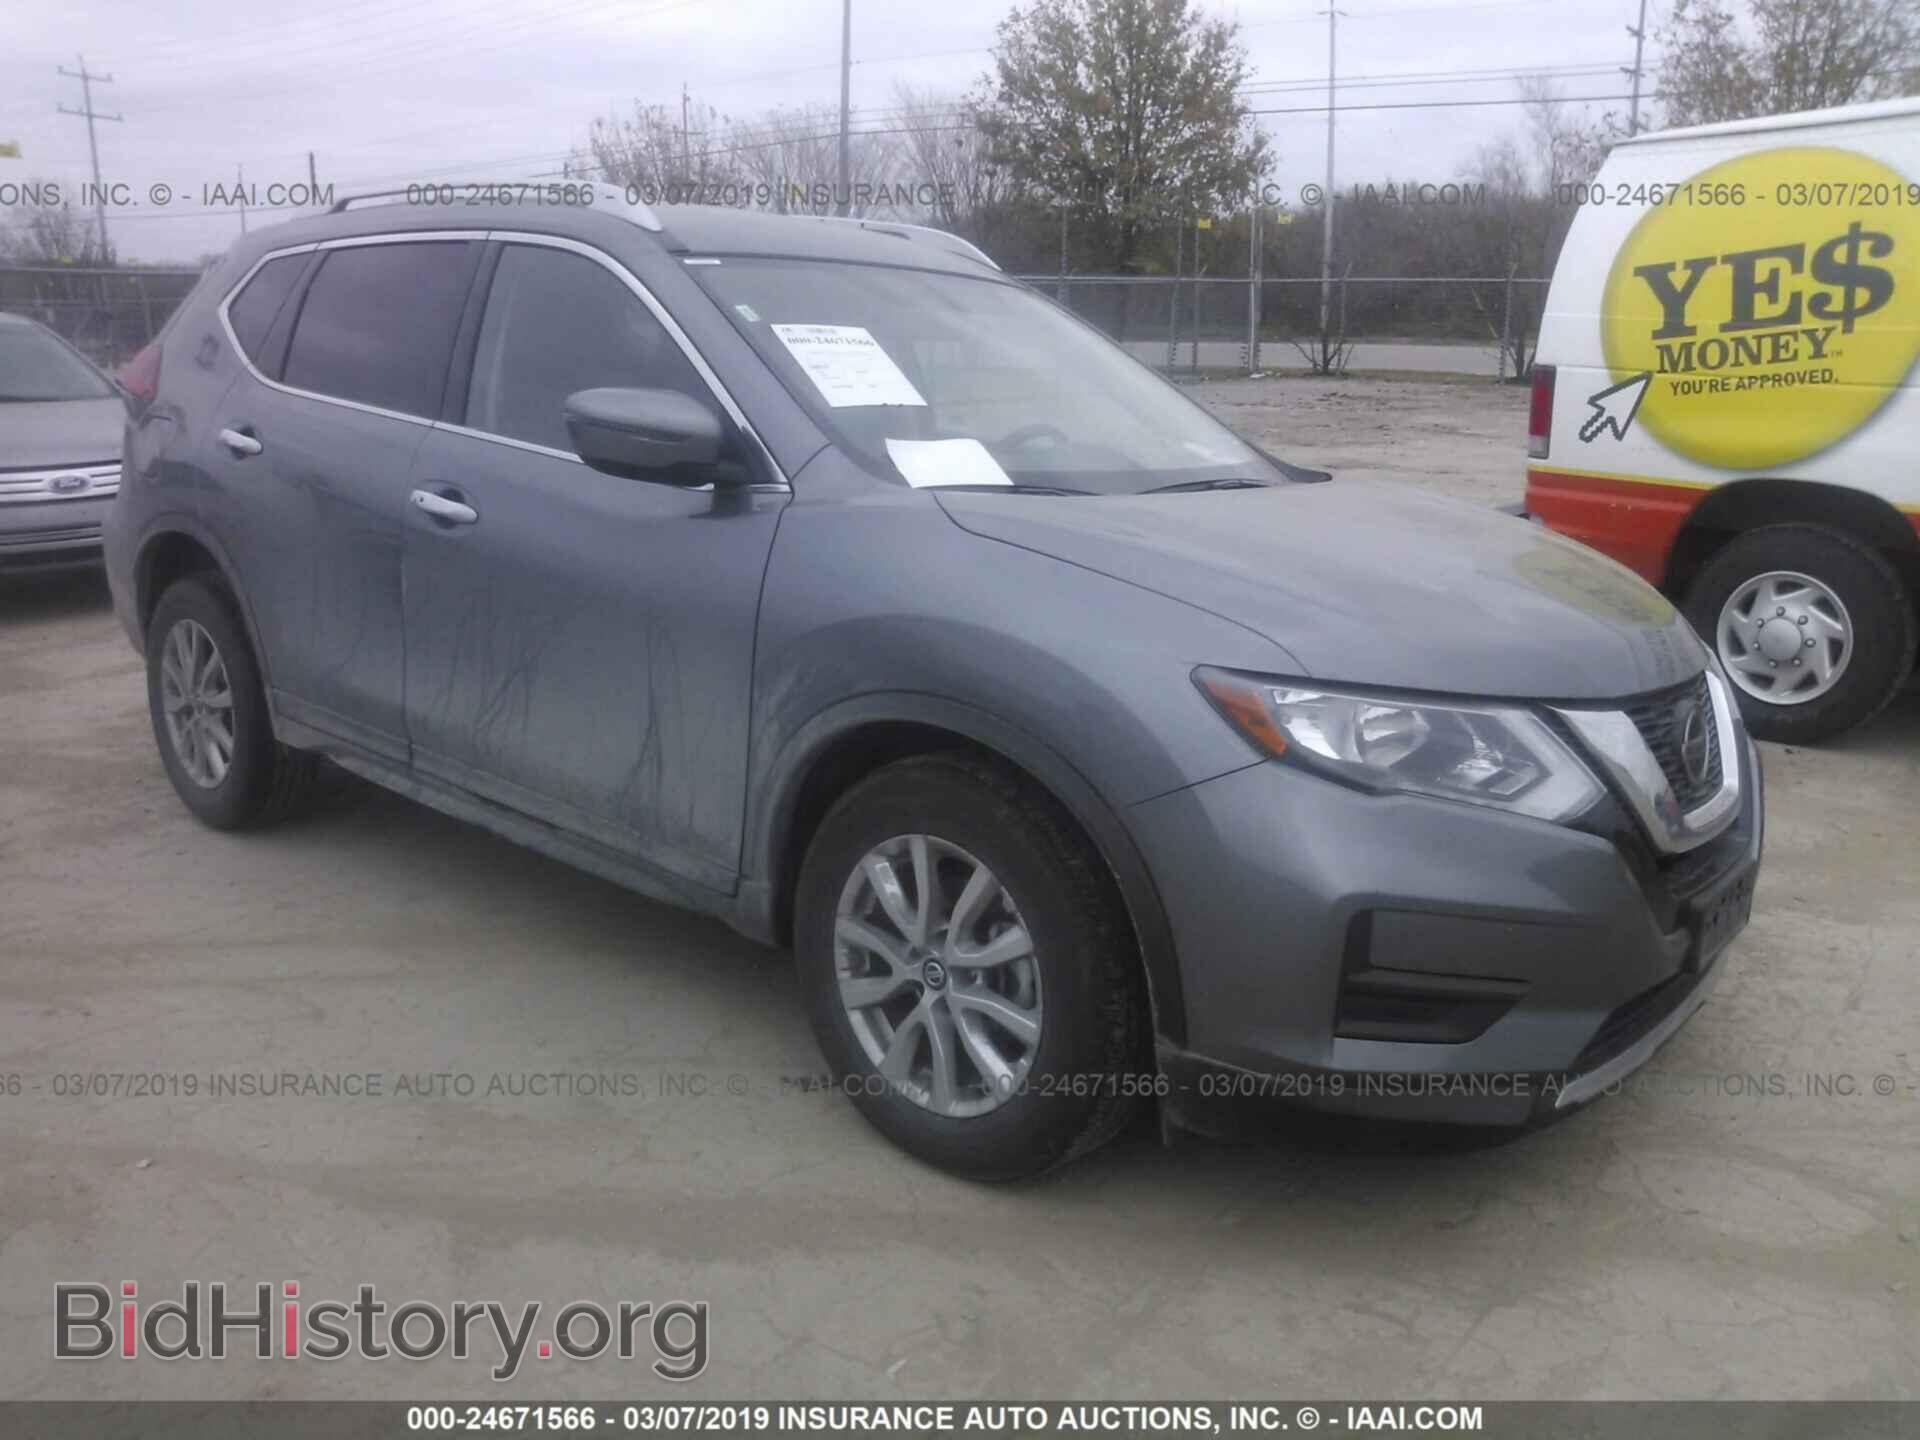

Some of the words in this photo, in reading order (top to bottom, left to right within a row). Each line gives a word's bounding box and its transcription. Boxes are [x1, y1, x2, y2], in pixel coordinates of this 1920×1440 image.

[1634, 221, 1895, 339] YE$
[1656, 326, 1838, 374] MONEY
[1670, 377, 1731, 397] YOU'RE
[1735, 368, 1839, 392] APPROVED.
